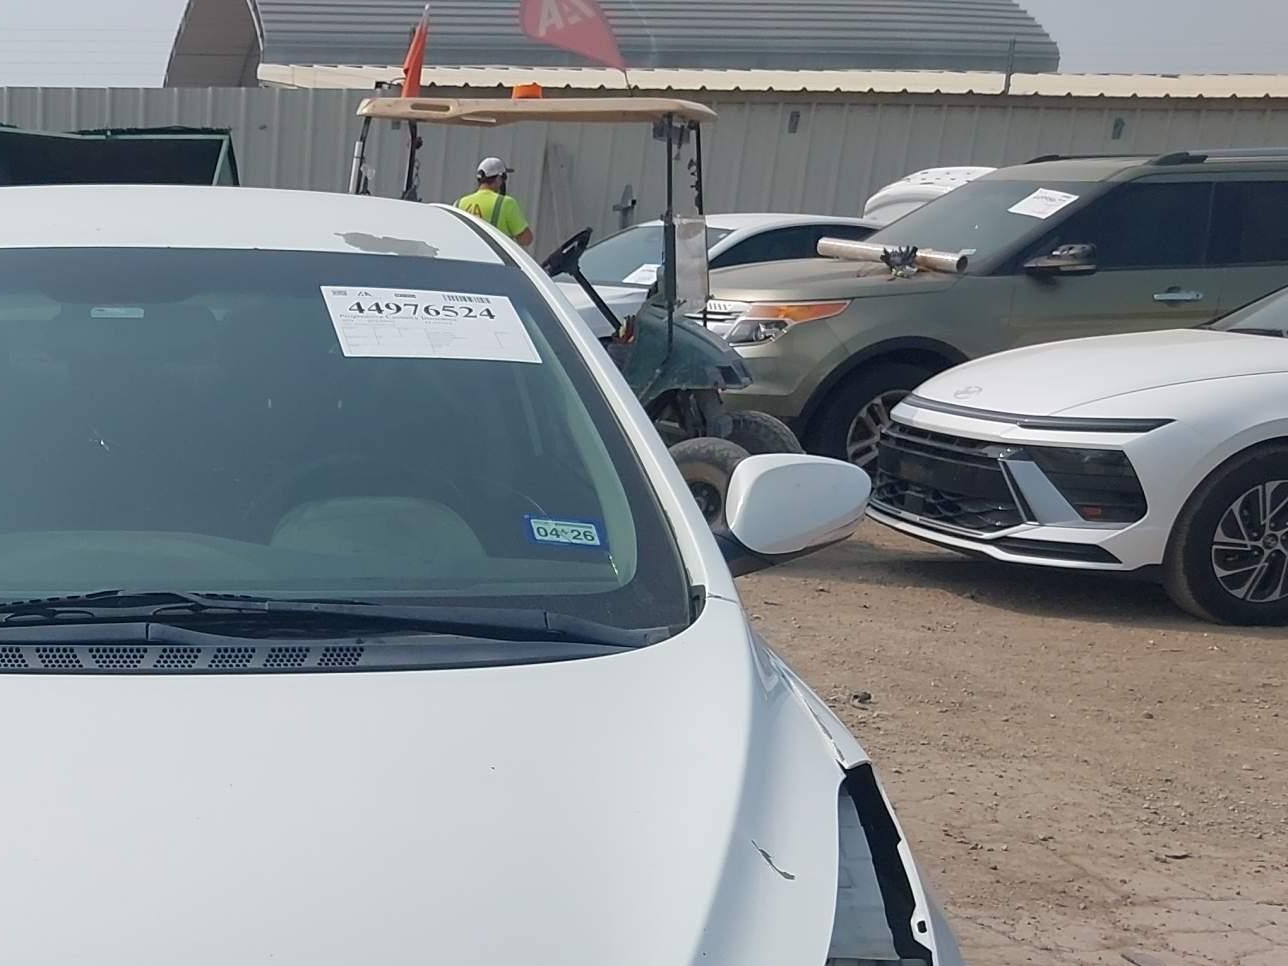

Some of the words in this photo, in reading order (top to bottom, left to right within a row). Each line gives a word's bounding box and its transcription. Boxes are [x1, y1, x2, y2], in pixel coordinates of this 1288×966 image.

[348, 301, 496, 320] 44976524
[536, 526, 561, 539] 04
[570, 529, 595, 542] 26
